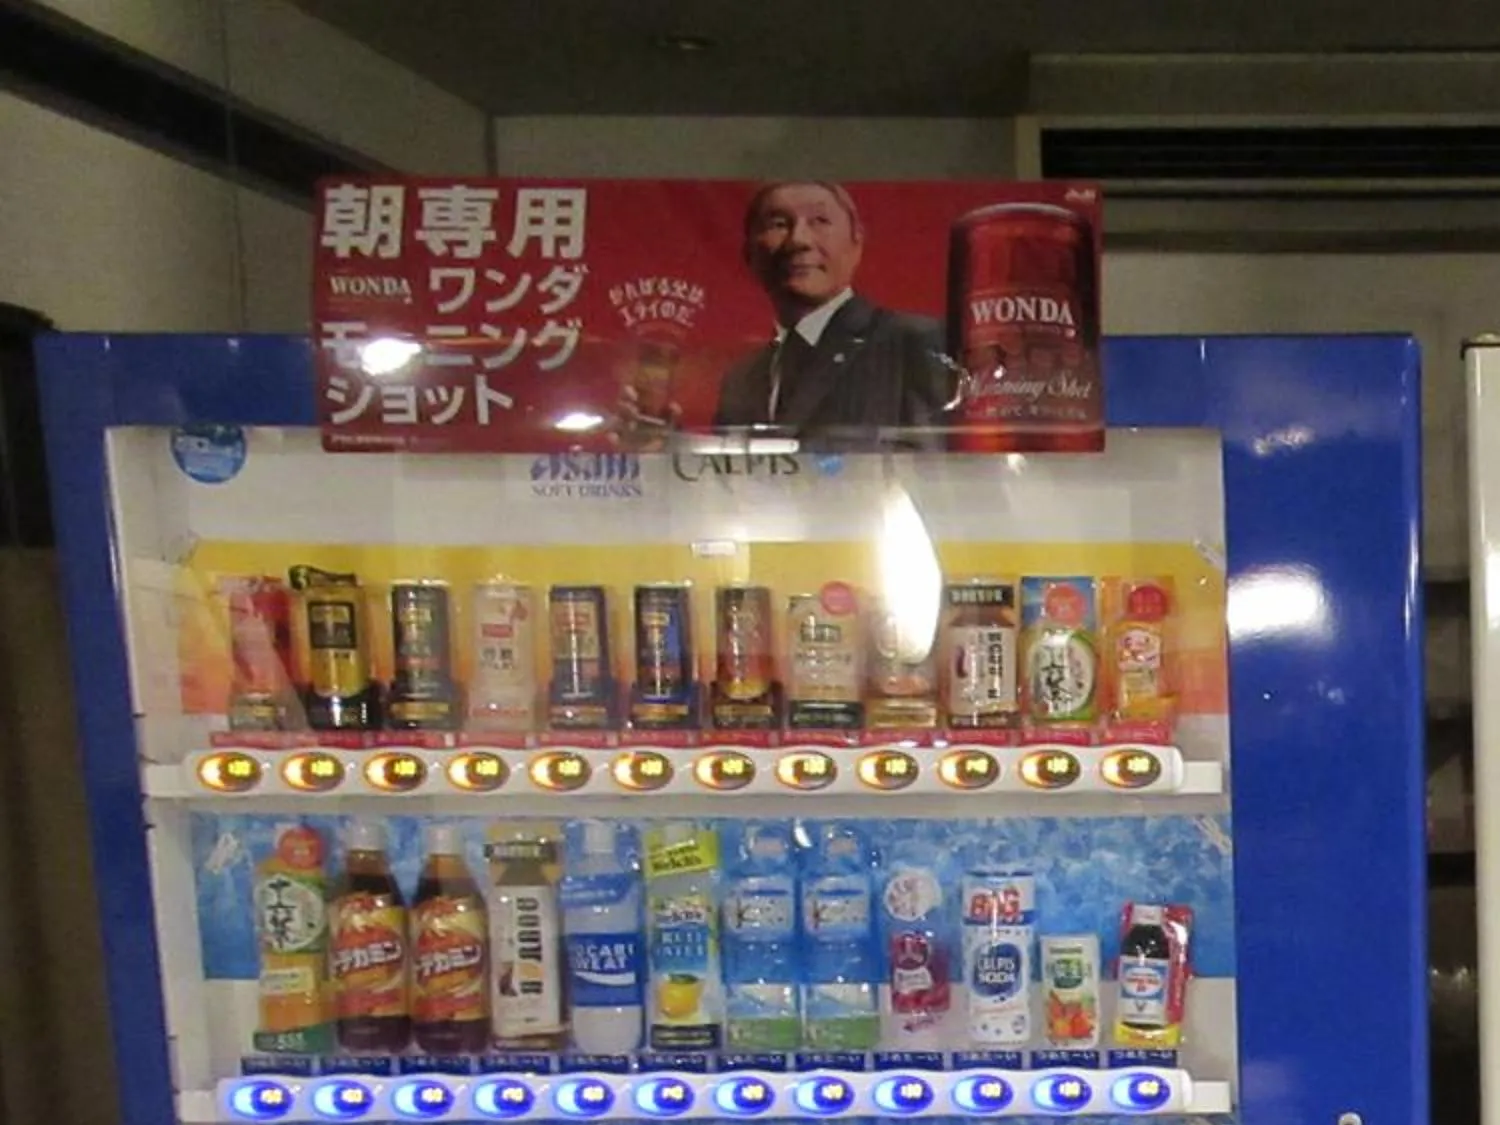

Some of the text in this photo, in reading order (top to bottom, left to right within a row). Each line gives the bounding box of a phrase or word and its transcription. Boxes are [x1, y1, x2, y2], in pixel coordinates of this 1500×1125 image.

[321, 185, 588, 260] 朝専用
[329, 275, 411, 297] WONDA
[428, 264, 589, 314] ワンダ
[970, 297, 1075, 326] WONDA
[321, 318, 584, 372] モニング
[324, 374, 513, 426] ショット
